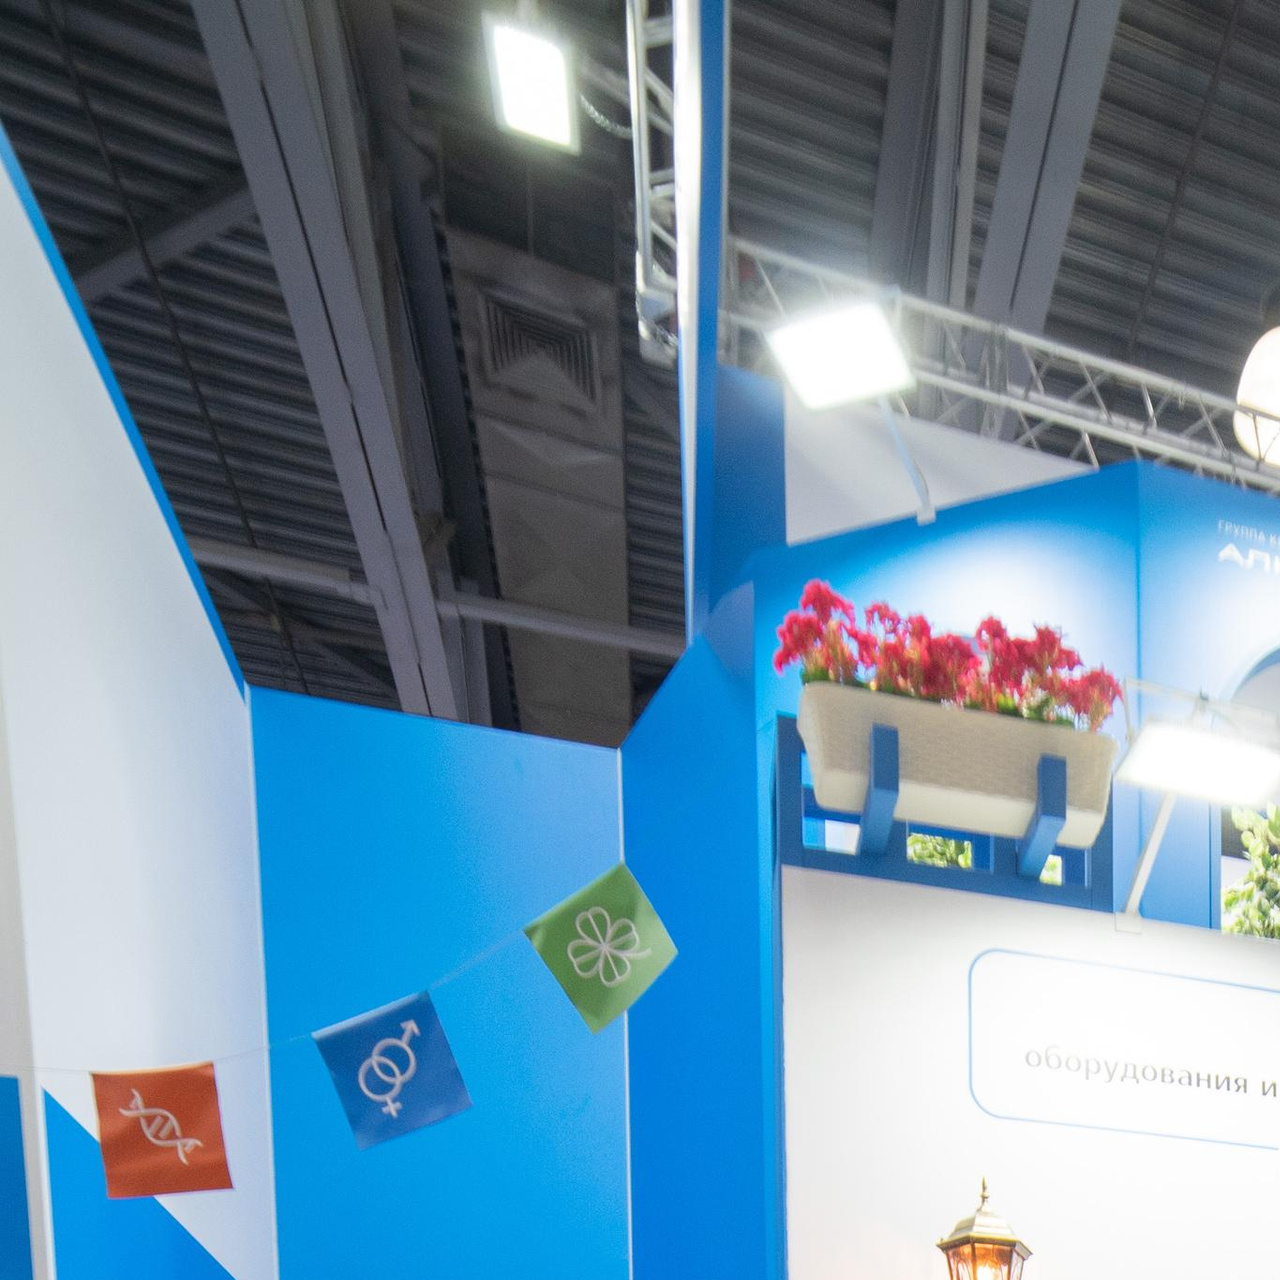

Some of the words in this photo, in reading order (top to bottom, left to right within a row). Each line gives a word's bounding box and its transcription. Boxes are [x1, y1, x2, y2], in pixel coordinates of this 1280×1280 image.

[1218, 519, 1266, 543] ГРУППА
[1025, 1043, 1248, 1094] оборудования
[1260, 1080, 1278, 1098] и
